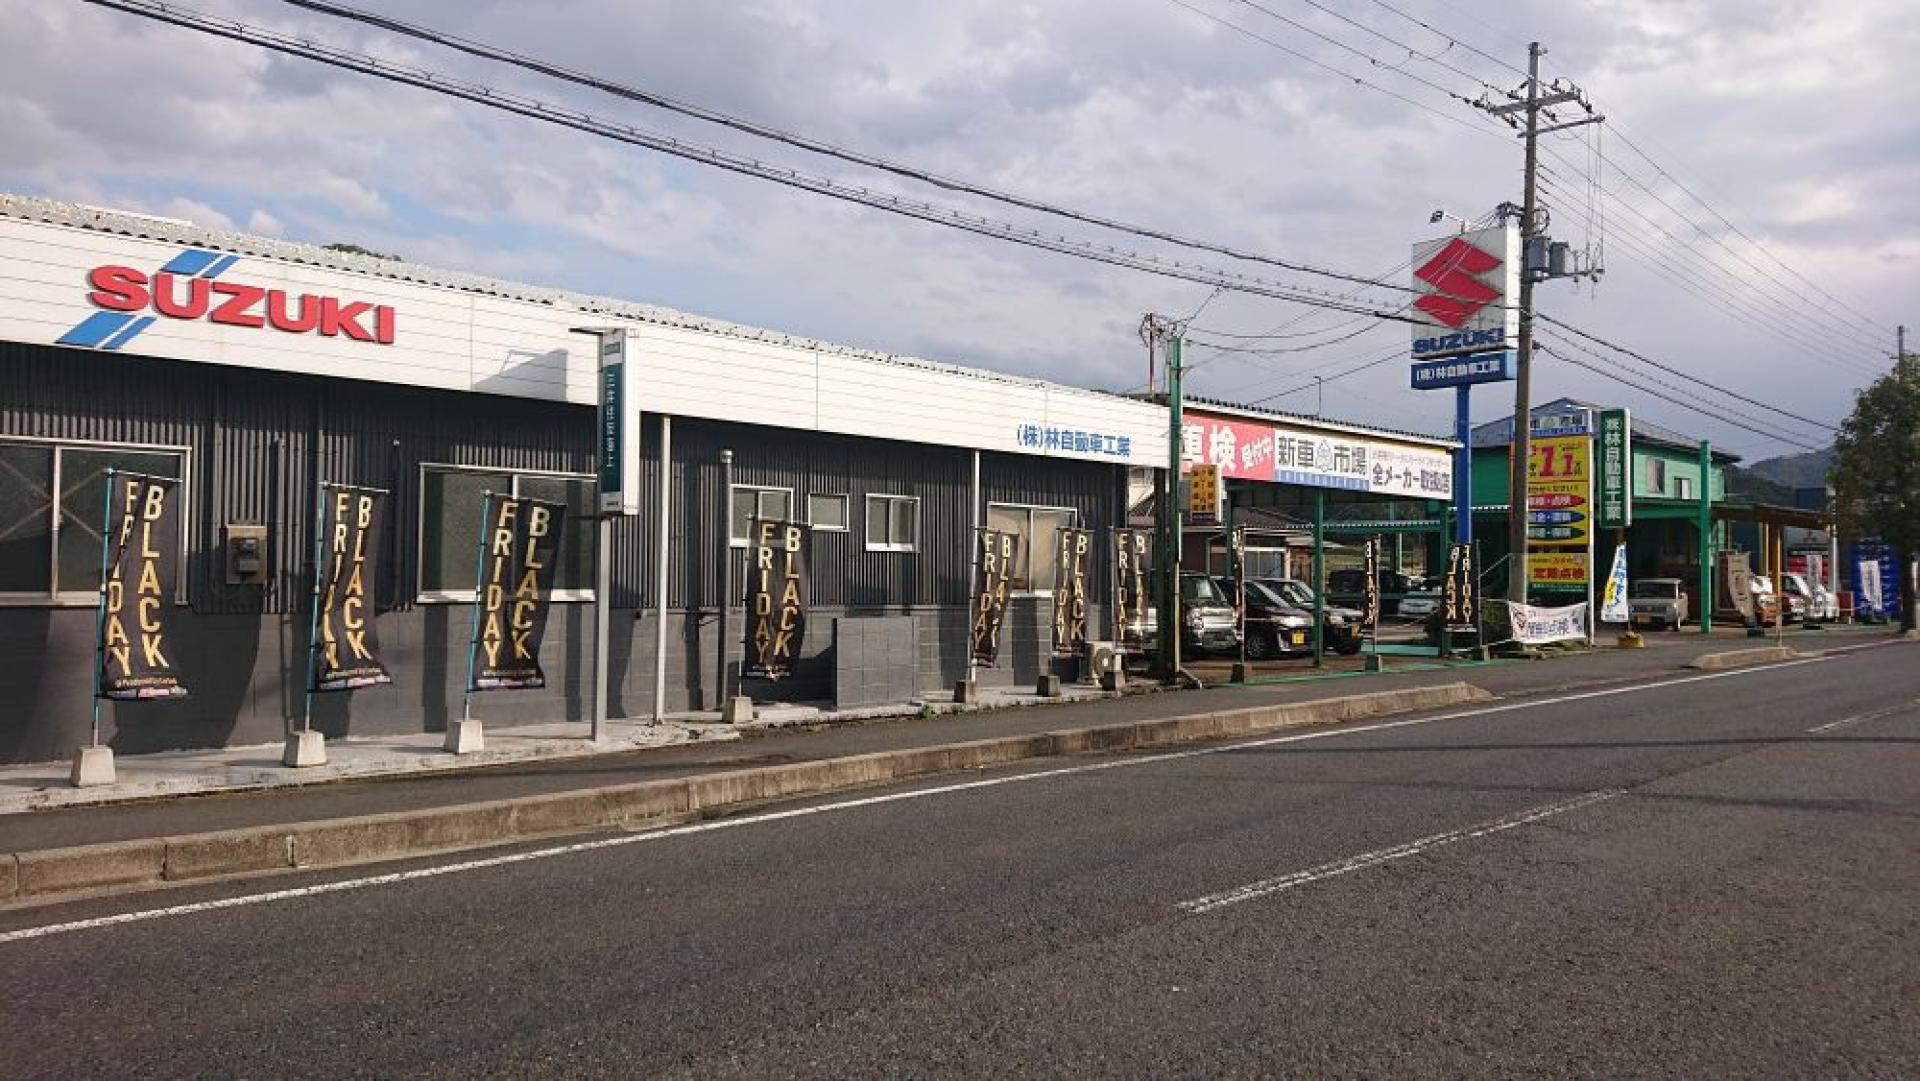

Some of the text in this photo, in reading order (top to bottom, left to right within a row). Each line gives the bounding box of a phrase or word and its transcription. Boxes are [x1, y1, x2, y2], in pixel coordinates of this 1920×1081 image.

[90, 265, 395, 344] SUZUKI
[1413, 326, 1504, 353] SUZUKI
[1017, 423, 1130, 457] (株)林自動車工業
[108, 481, 139, 677] FRIDAY
[138, 485, 170, 669] BLACK
[345, 496, 373, 660] BLACK
[483, 501, 519, 667] FRIDAY
[511, 506, 550, 660] BLACK
[755, 523, 775, 663] FRIDAY
[773, 527, 801, 658] BLACK
[975, 533, 995, 649] FRIDAY
[1057, 532, 1072, 644] FRIDAY
[1071, 535, 1088, 641] BLACK
